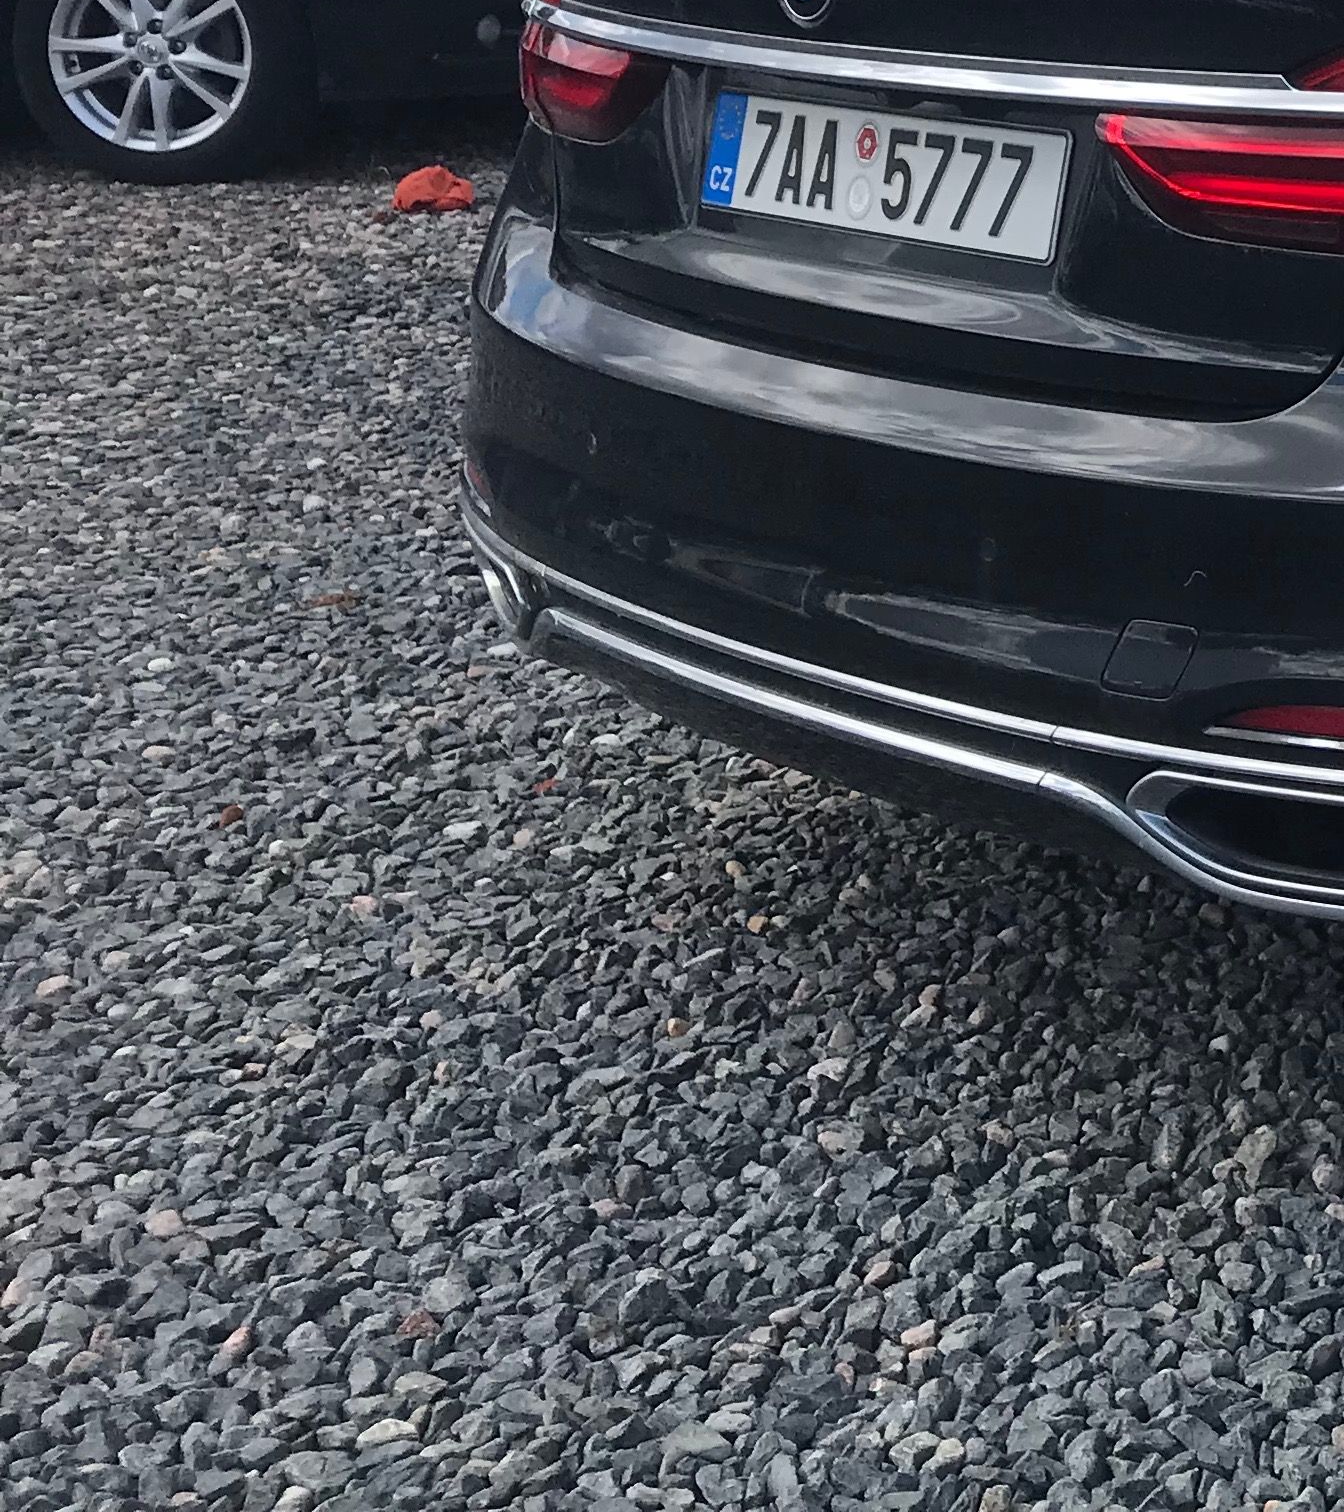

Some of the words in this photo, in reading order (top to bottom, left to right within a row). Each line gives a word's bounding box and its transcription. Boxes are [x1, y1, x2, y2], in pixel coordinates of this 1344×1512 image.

[709, 165, 733, 192] CZ
[744, 109, 839, 210] 7AA
[880, 128, 1035, 238] 5777
